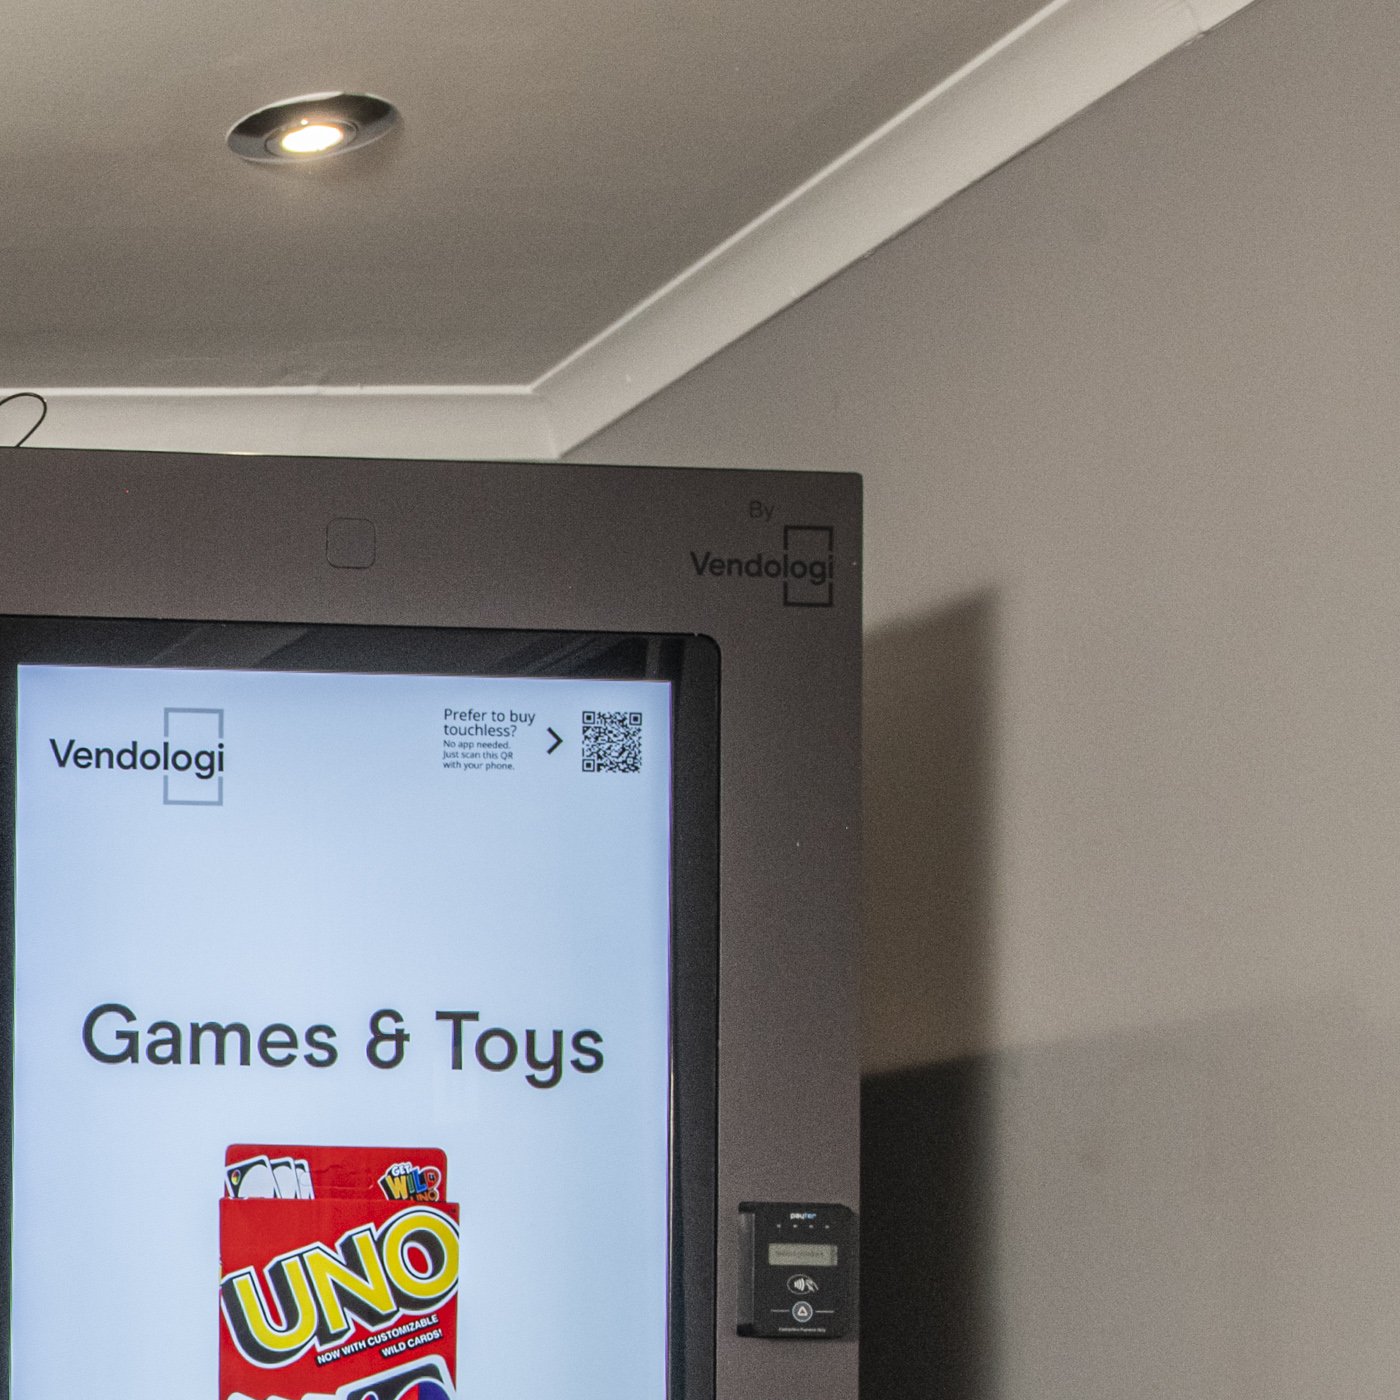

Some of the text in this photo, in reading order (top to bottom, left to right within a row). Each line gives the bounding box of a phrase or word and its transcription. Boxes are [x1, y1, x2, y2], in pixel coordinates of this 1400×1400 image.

[749, 501, 774, 522] By
[690, 550, 834, 585] Vendologi
[444, 708, 536, 726] Prefer to buy
[443, 724, 517, 737] touchless?
[442, 751, 514, 761] Just scan this QR
[443, 740, 511, 751] No app needed.
[49, 738, 224, 780] Vendologi
[443, 761, 515, 771] with your phone.
[82, 1003, 604, 1090] Games & Toys
[391, 1165, 410, 1176] GET
[385, 1168, 440, 1200] WILD
[222, 1207, 459, 1367] UNO
[317, 1314, 439, 1364] NOW WITH CUSTOMIZABLE
[381, 1329, 443, 1357] WILD CARDS!
